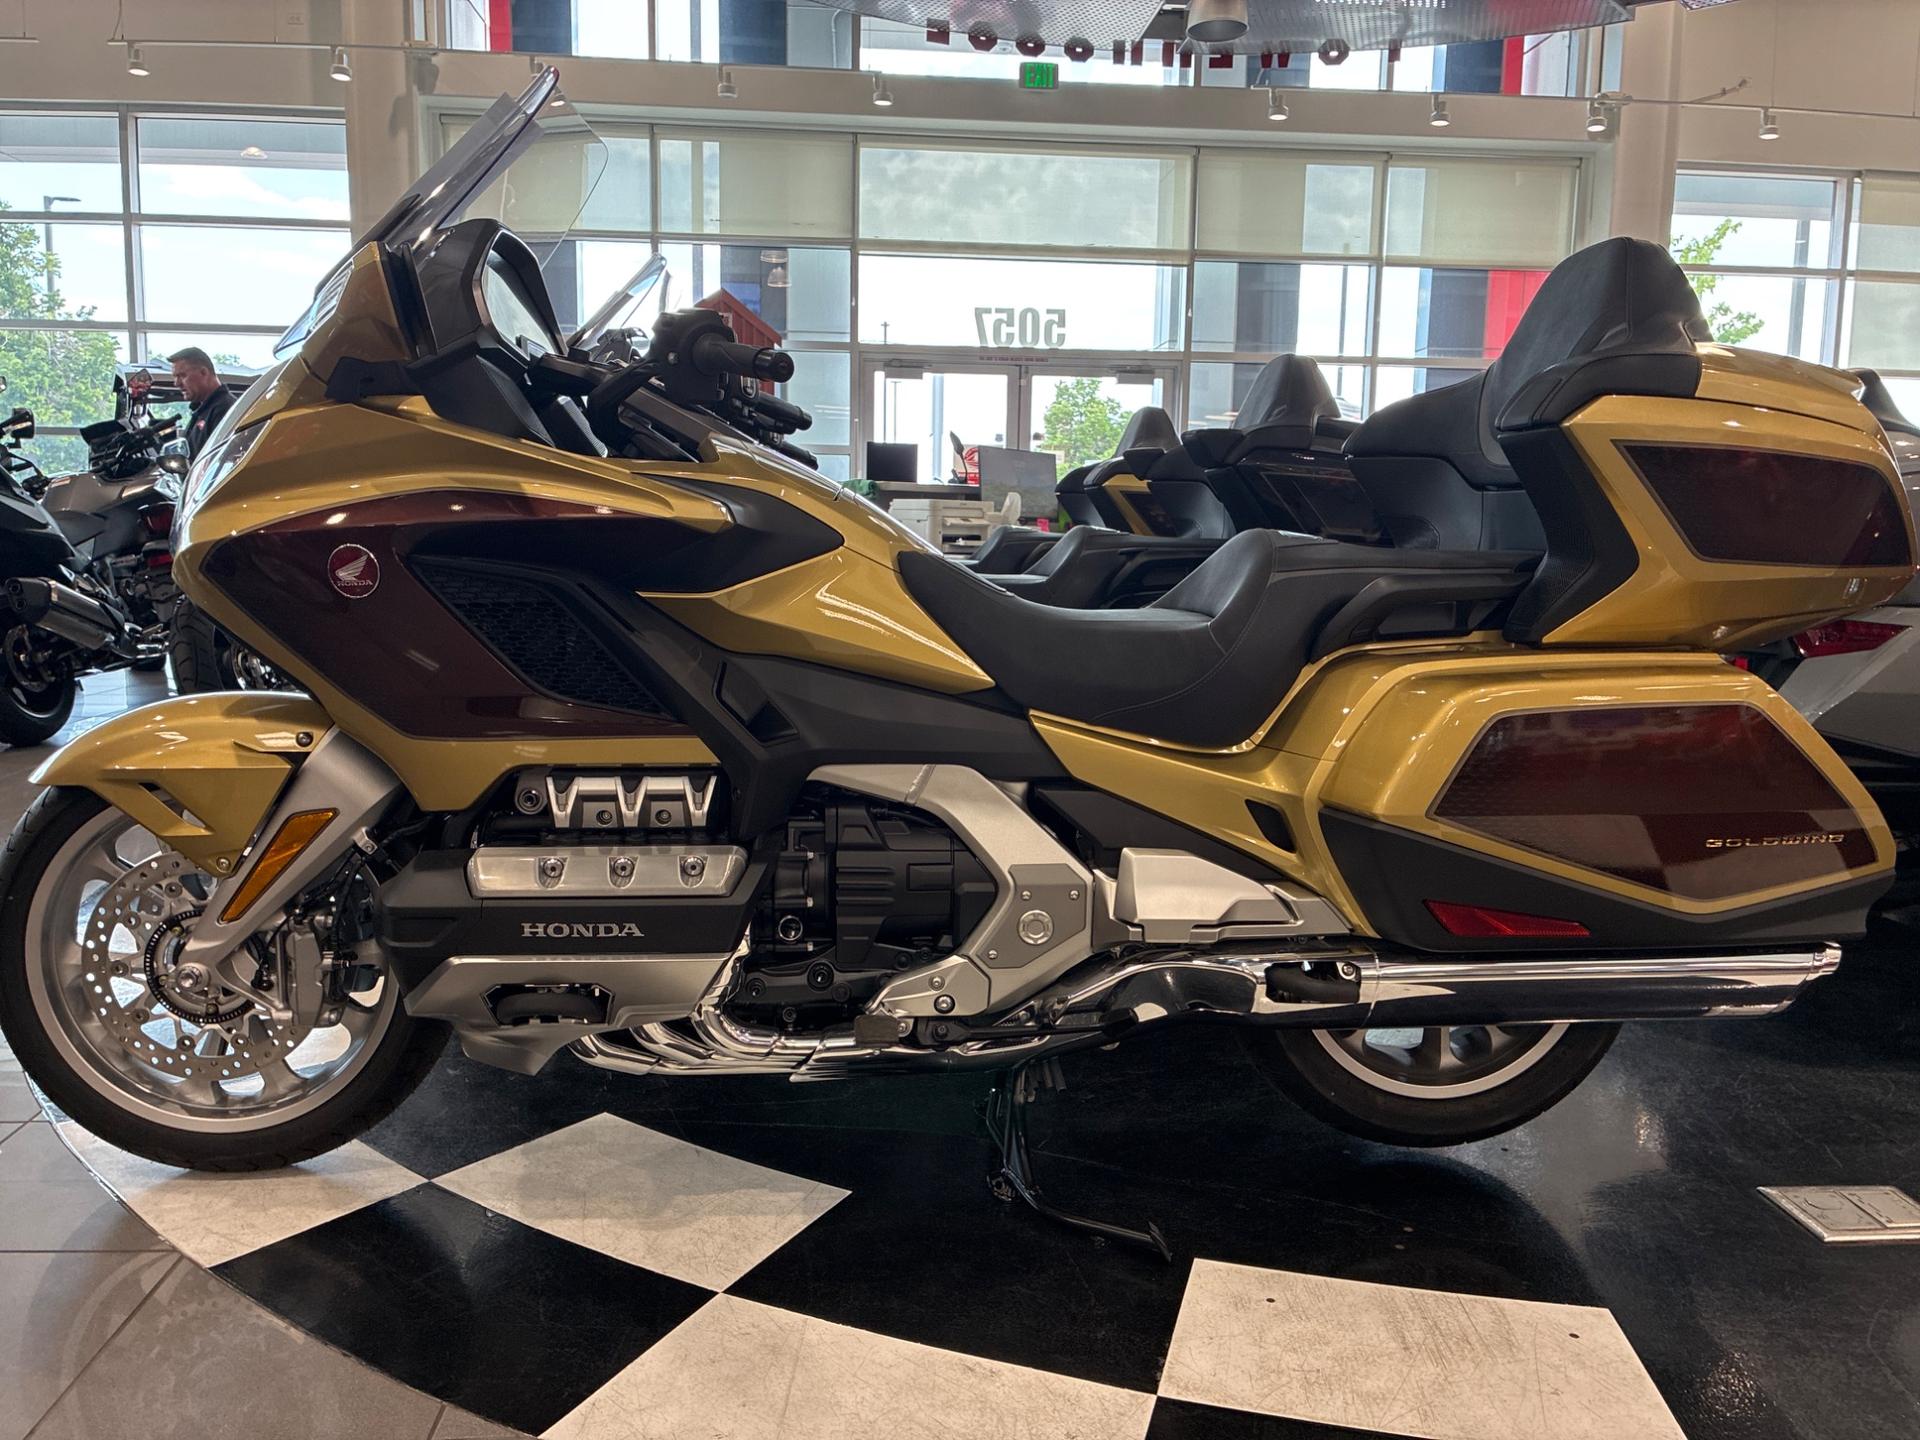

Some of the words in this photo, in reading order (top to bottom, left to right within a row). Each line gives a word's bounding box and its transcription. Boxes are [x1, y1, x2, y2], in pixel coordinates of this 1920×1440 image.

[1025, 63, 1055, 89] EXIT
[1705, 834, 1845, 848] GOLDWING
[520, 922, 645, 938] HONDA
